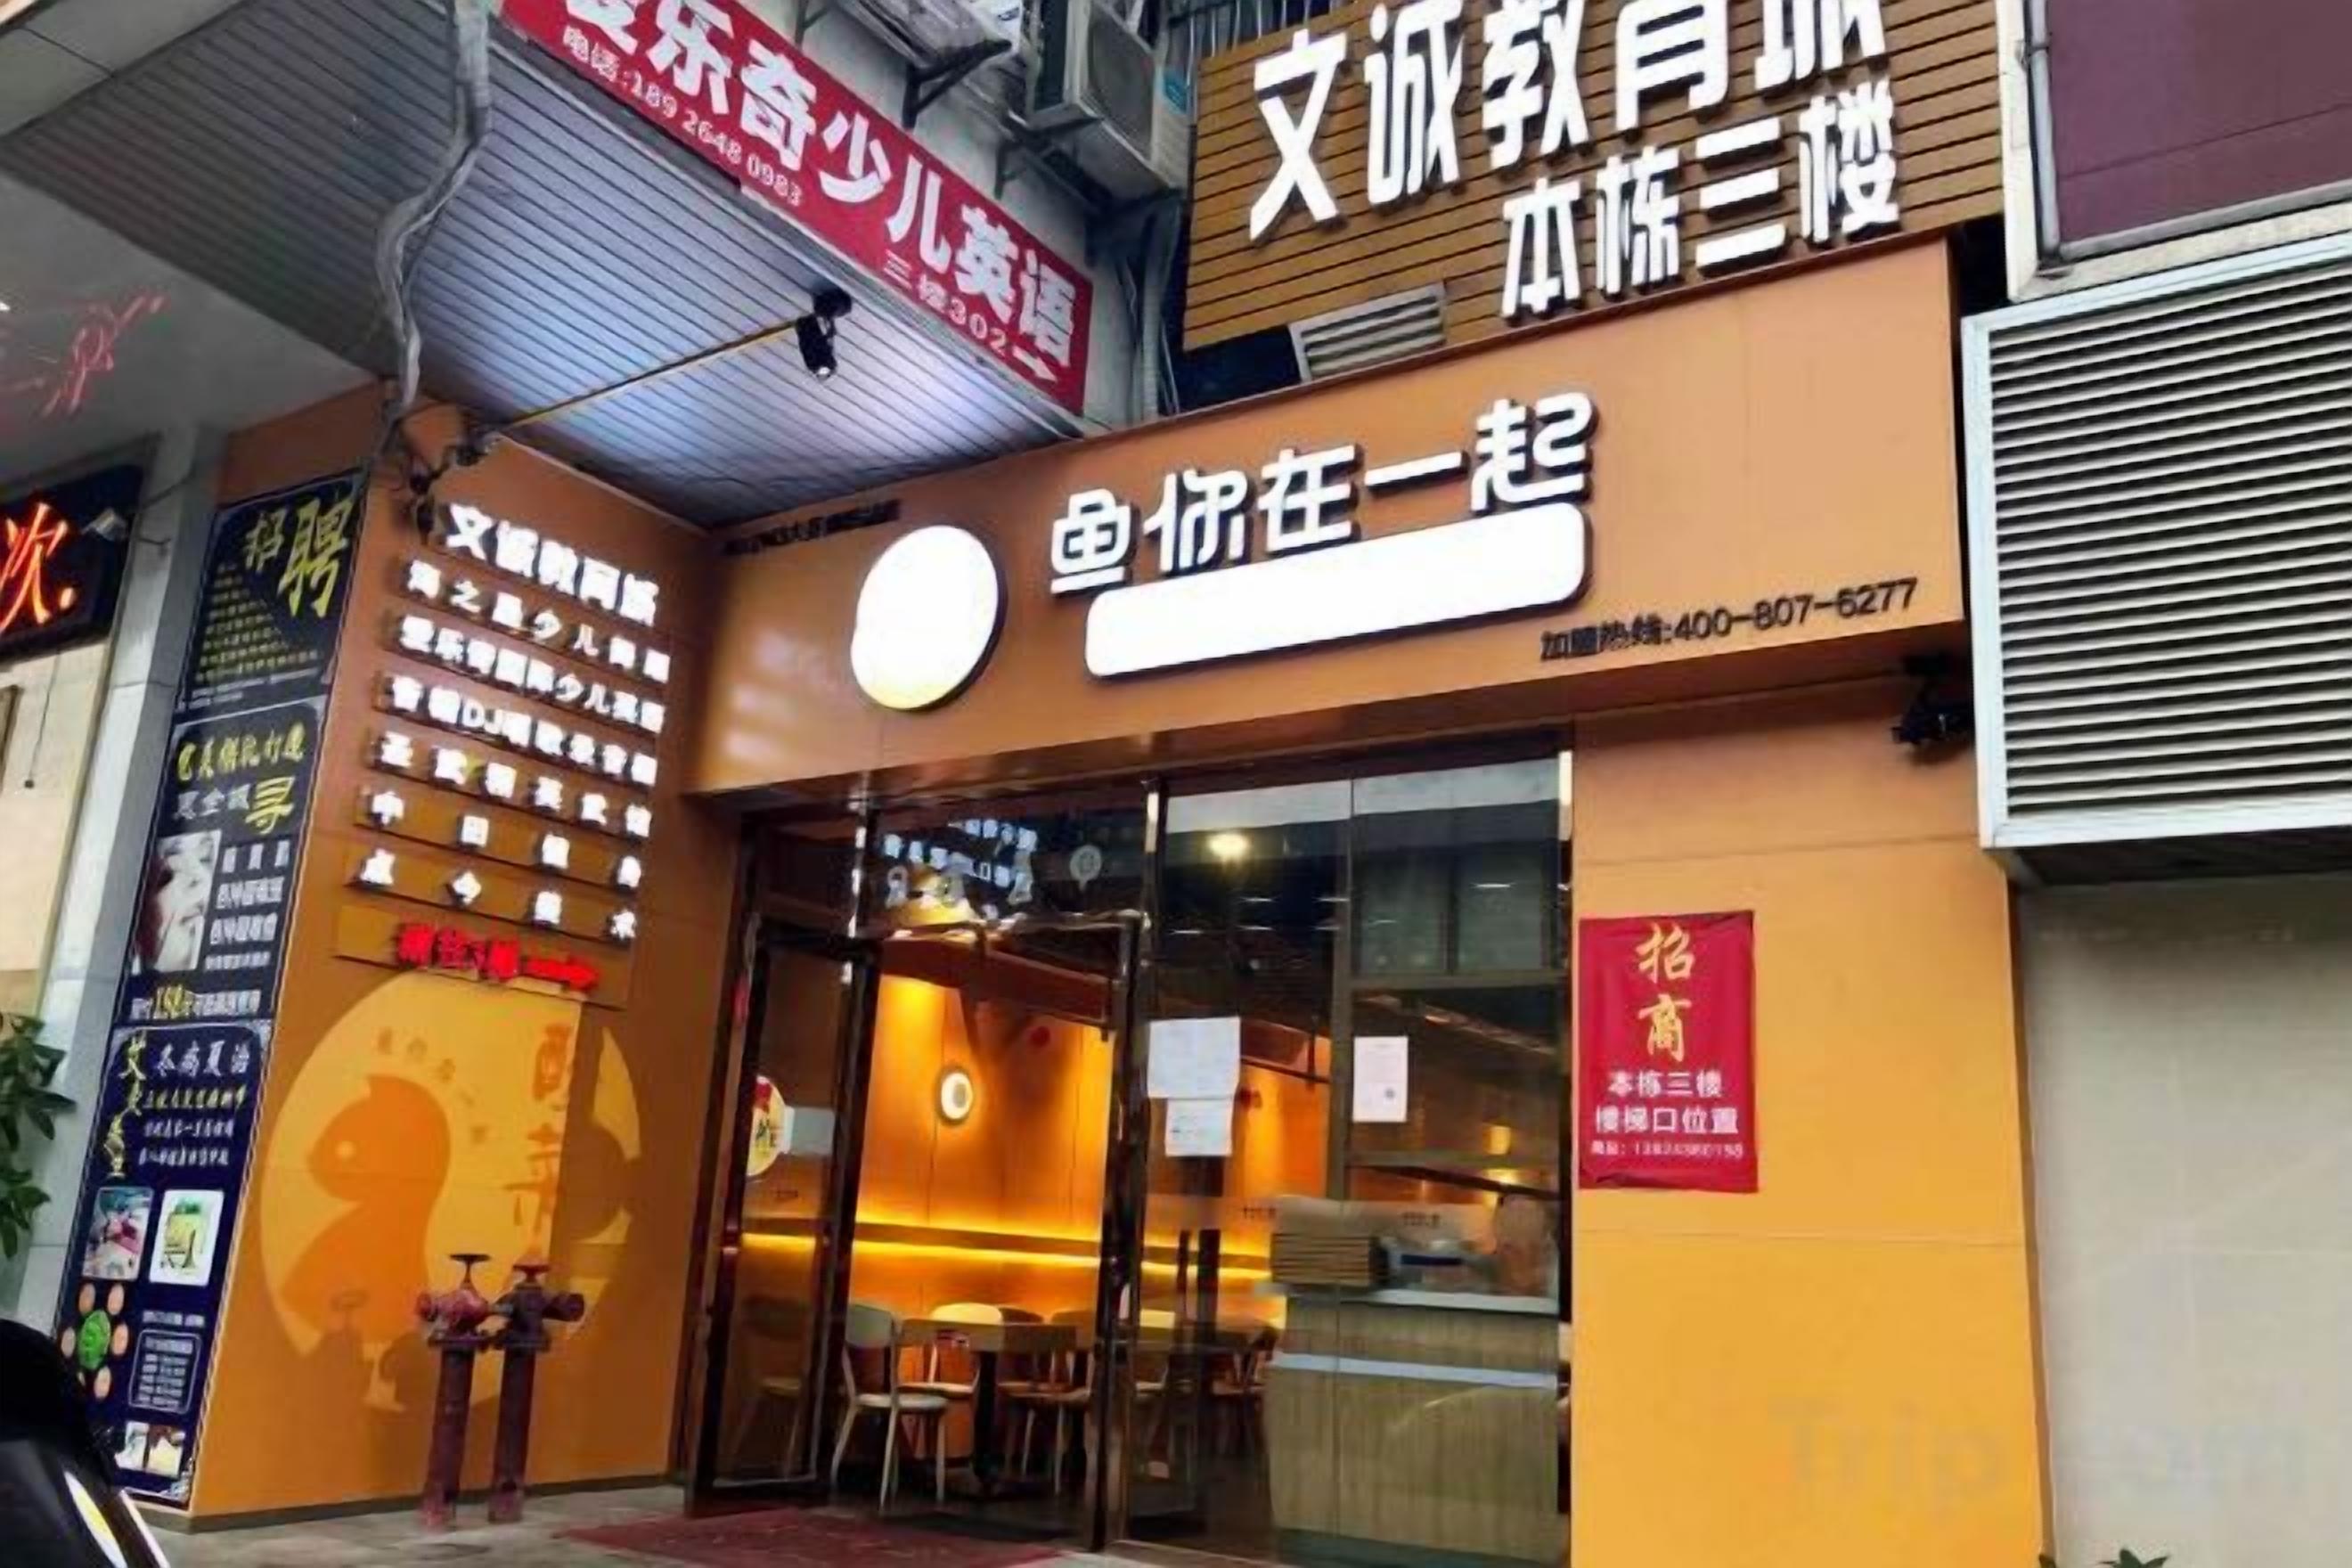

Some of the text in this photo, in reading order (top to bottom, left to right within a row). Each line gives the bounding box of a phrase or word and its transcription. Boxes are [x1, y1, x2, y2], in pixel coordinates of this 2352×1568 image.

[1501, 77, 1900, 318] 本栋三楼
[1051, 392, 1594, 594] 鱼你在一起
[1636, 921, 1695, 1062] 招商
[1608, 1069, 1723, 1098] 本栋三楼
